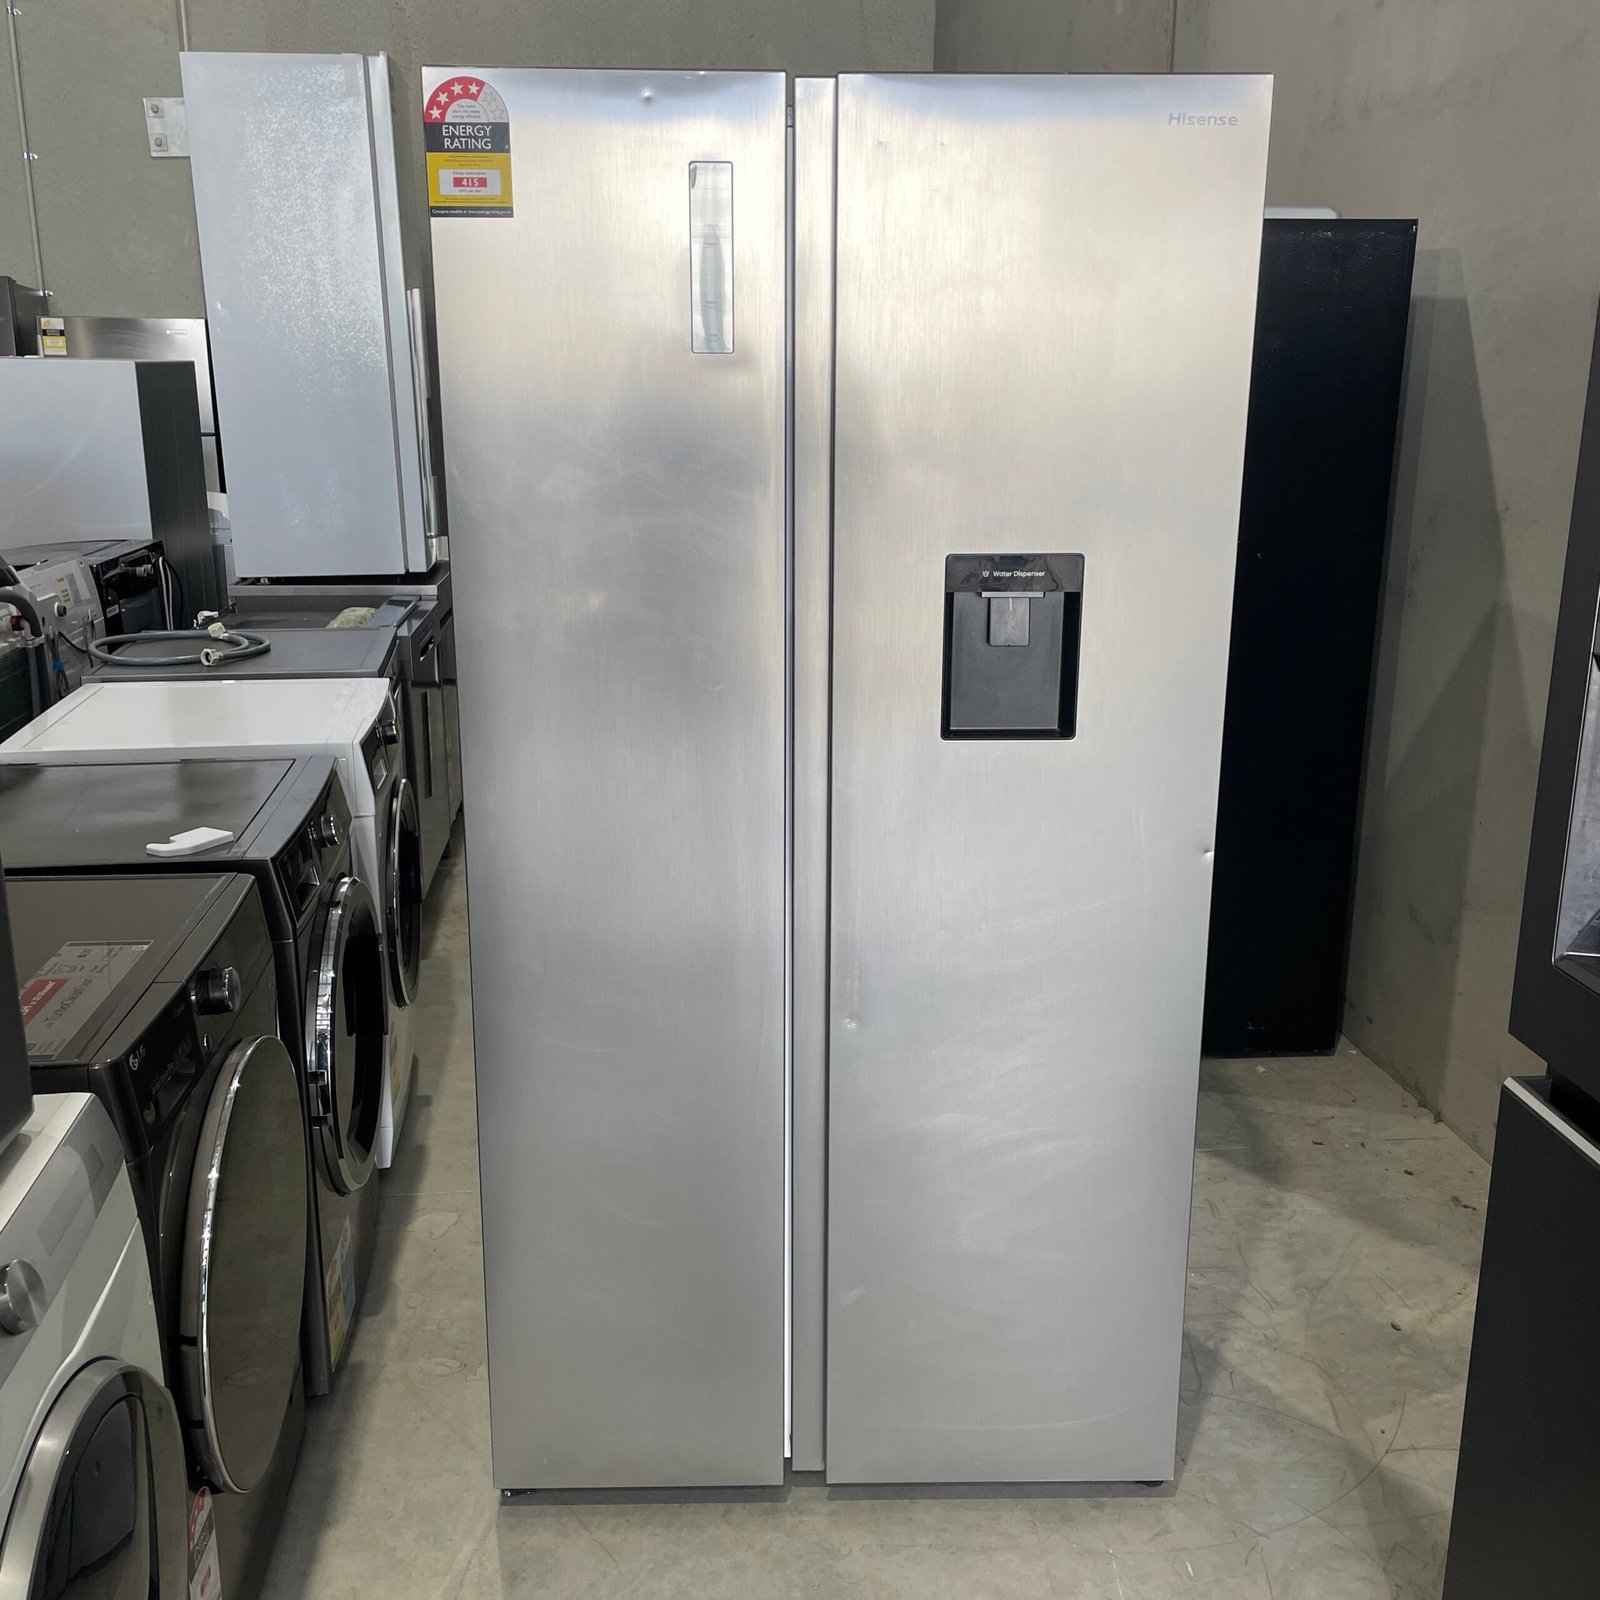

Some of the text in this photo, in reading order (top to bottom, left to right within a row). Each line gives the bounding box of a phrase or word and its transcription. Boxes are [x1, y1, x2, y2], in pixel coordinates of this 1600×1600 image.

[1167, 112, 1239, 126] Hisense
[442, 125, 492, 136] ENERGY
[444, 138, 492, 149] RATING
[461, 178, 479, 187] 415
[1013, 570, 1045, 578] Dispenser
